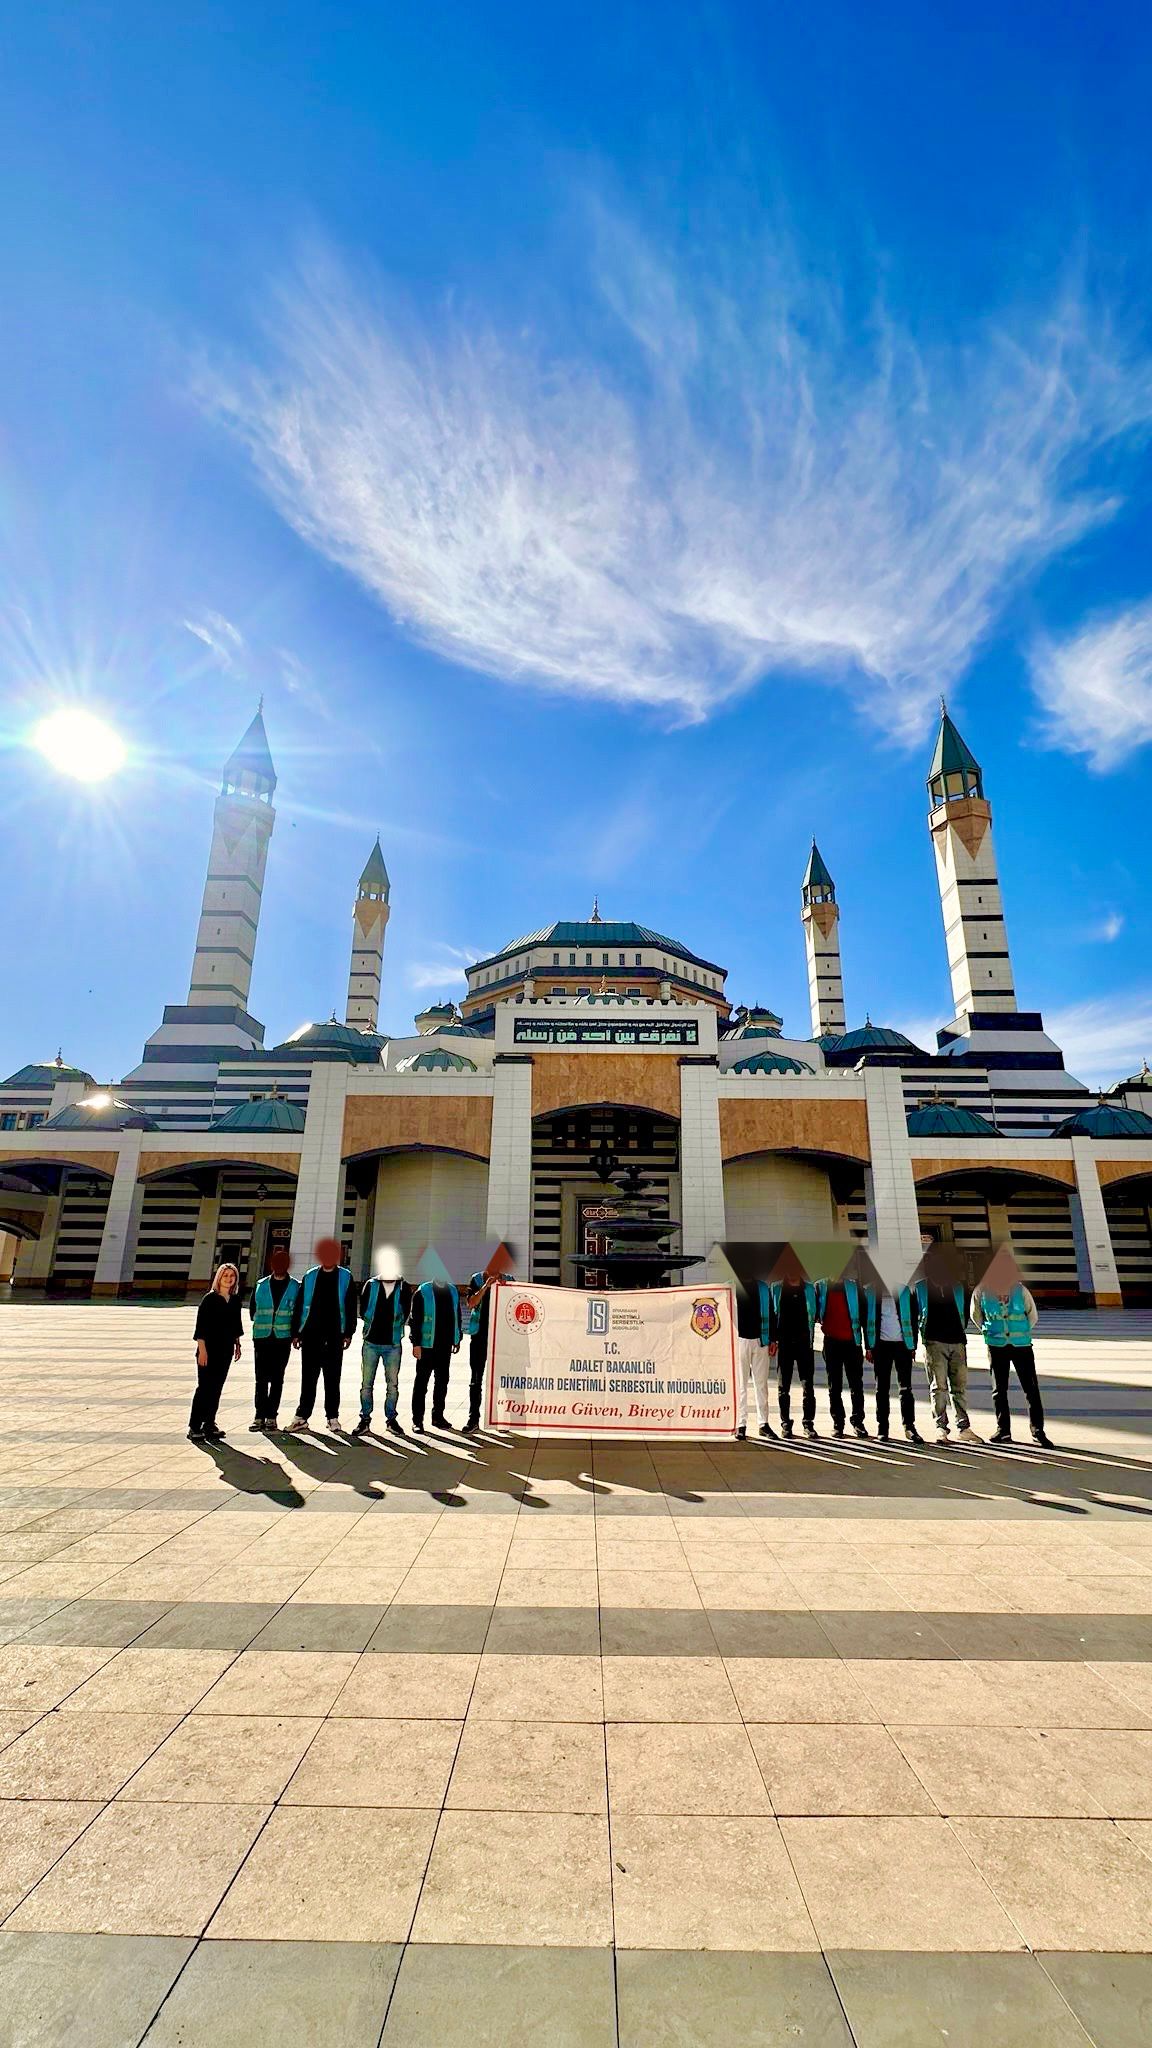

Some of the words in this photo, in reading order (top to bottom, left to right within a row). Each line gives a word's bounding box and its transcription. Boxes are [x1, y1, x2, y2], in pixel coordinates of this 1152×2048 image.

[604, 1342, 620, 1355] T.C.
[569, 1359, 603, 1372] ADALET
[607, 1359, 655, 1374] BAKANLIĞI
[501, 1373, 554, 1390] DİYARBAKIR
[557, 1376, 606, 1392] DENETİMLİ
[609, 1378, 664, 1394] SERBESTLİK
[667, 1379, 726, 1394] MÜDÜRLÜĞÜ
[497, 1399, 566, 1416] “Topluma
[572, 1402, 623, 1418] Güven,
[628, 1404, 674, 1421] Bireye
[680, 1405, 730, 1419] Umut”
